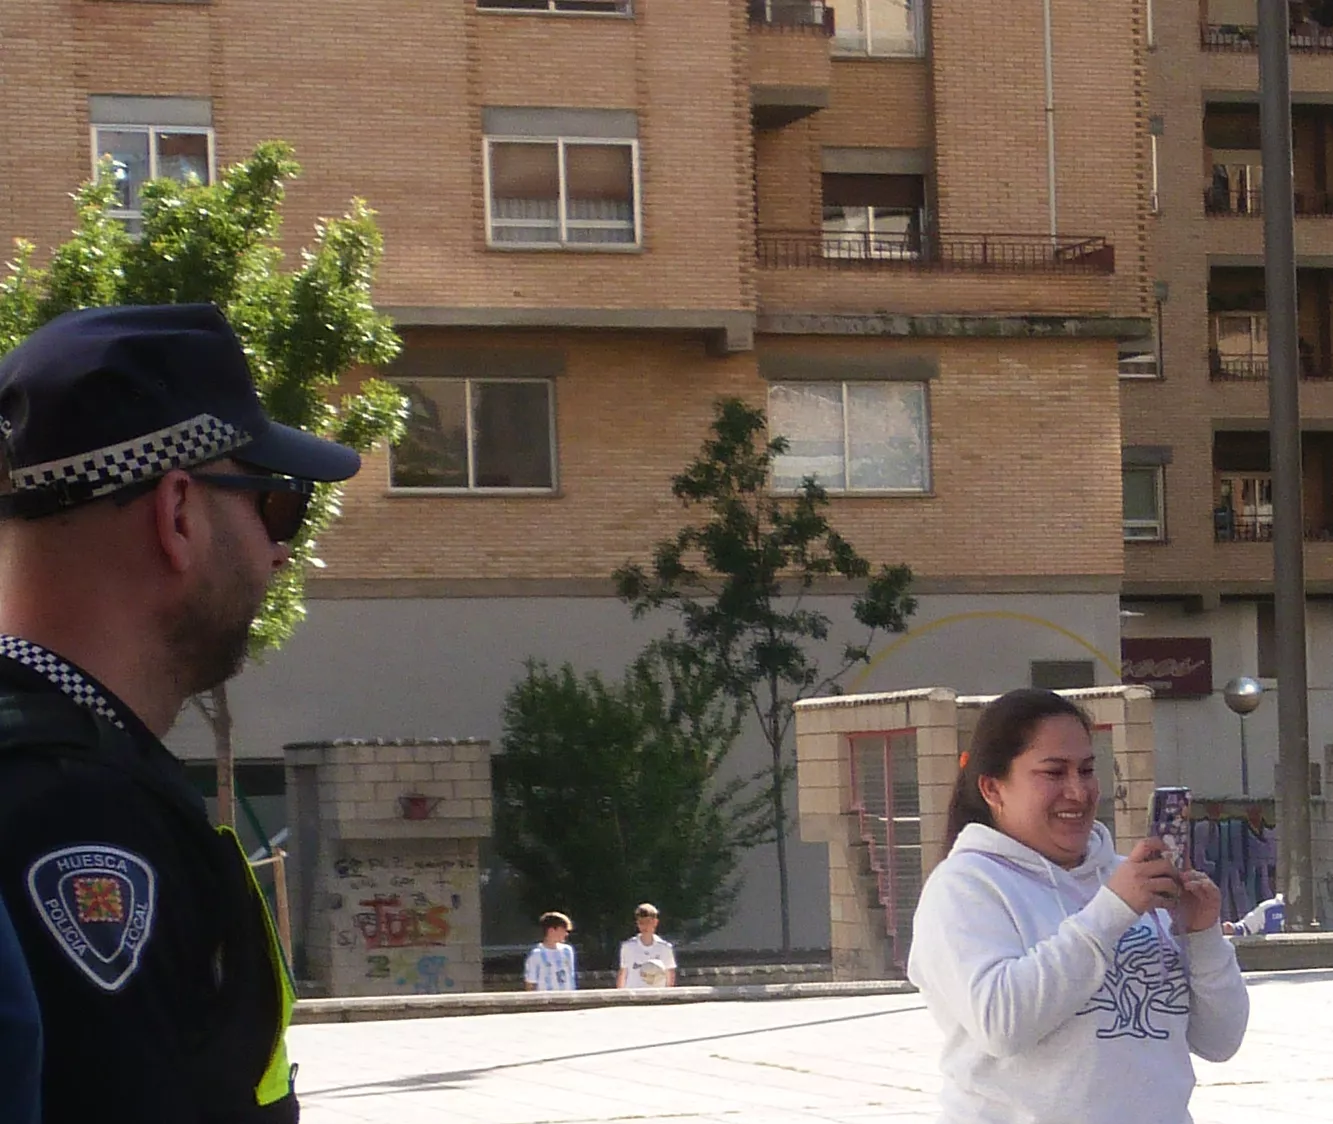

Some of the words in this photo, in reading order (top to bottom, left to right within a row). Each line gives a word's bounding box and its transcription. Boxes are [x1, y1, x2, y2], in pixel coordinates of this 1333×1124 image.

[55, 854, 128, 872] HUESCA
[45, 898, 88, 957] POLICIA
[125, 902, 149, 950] LOCAL
